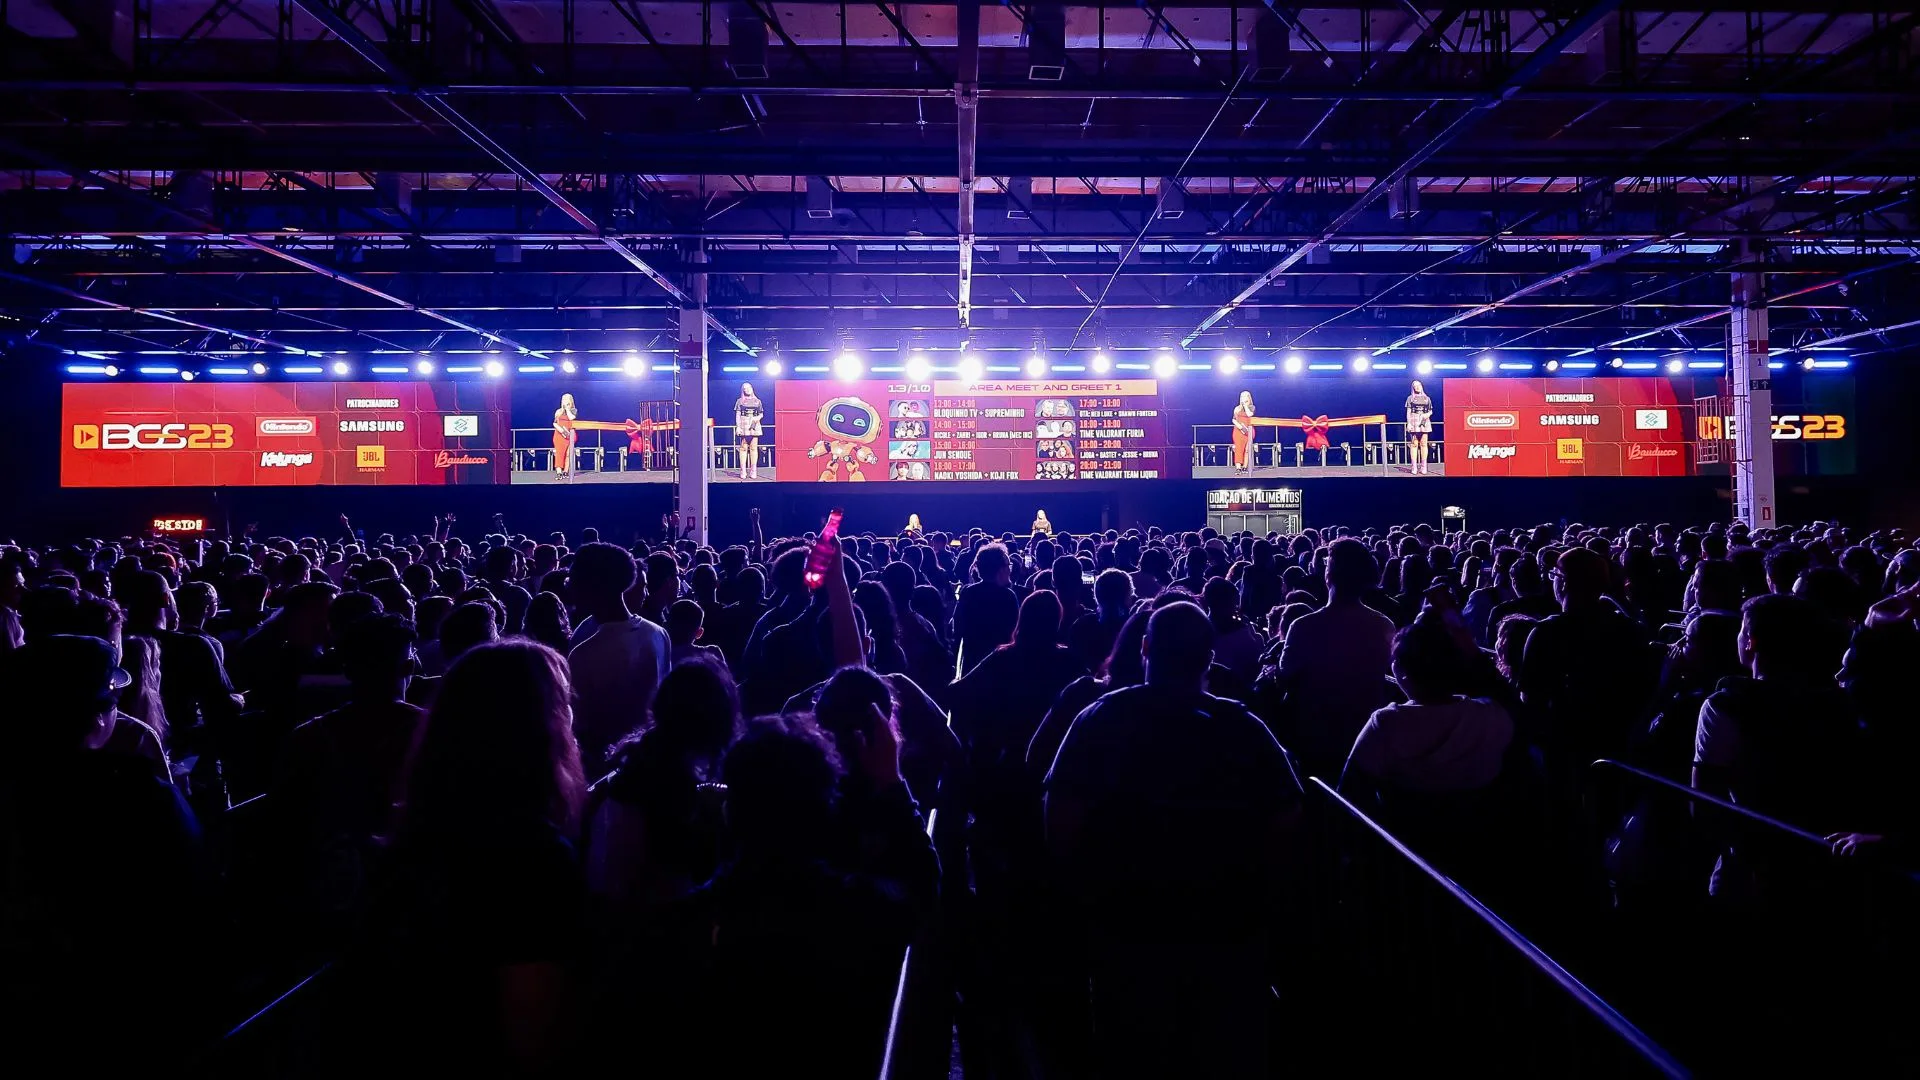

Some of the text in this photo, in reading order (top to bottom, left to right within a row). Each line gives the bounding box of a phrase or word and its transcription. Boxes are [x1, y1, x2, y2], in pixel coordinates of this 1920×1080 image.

[888, 384, 931, 394] 13/10
[1545, 394, 1595, 403] PATROCINADORES
[346, 399, 399, 408] PATROCINADORES
[934, 409, 968, 418] BLOQUINHO
[970, 409, 977, 418] TV
[984, 408, 1025, 418] SUPREMINHO
[1471, 416, 1511, 425] Nintendo
[1540, 414, 1600, 425] SAMSUNG
[264, 422, 308, 431] Nintendo
[340, 421, 404, 432] SAMSUNG
[1080, 429, 1144, 438] TIME VALORANT FURIA
[1468, 444, 1516, 459] Kalunga
[1563, 444, 1578, 453] JBL
[1628, 443, 1678, 460] Bauducco
[260, 452, 312, 467] Kalunga
[363, 452, 379, 461] JBL
[434, 450, 488, 468] Bauducco
[934, 471, 953, 480] NAOKI
[955, 471, 982, 480] YOSHIDA
[990, 471, 1005, 480] KOJI
[1006, 471, 1018, 480] FOX
[1080, 471, 1158, 480] TIME VALORANT TEAM LIQUID
[1241, 491, 1252, 503] DE
[1255, 491, 1300, 503] ALIMENTOS
